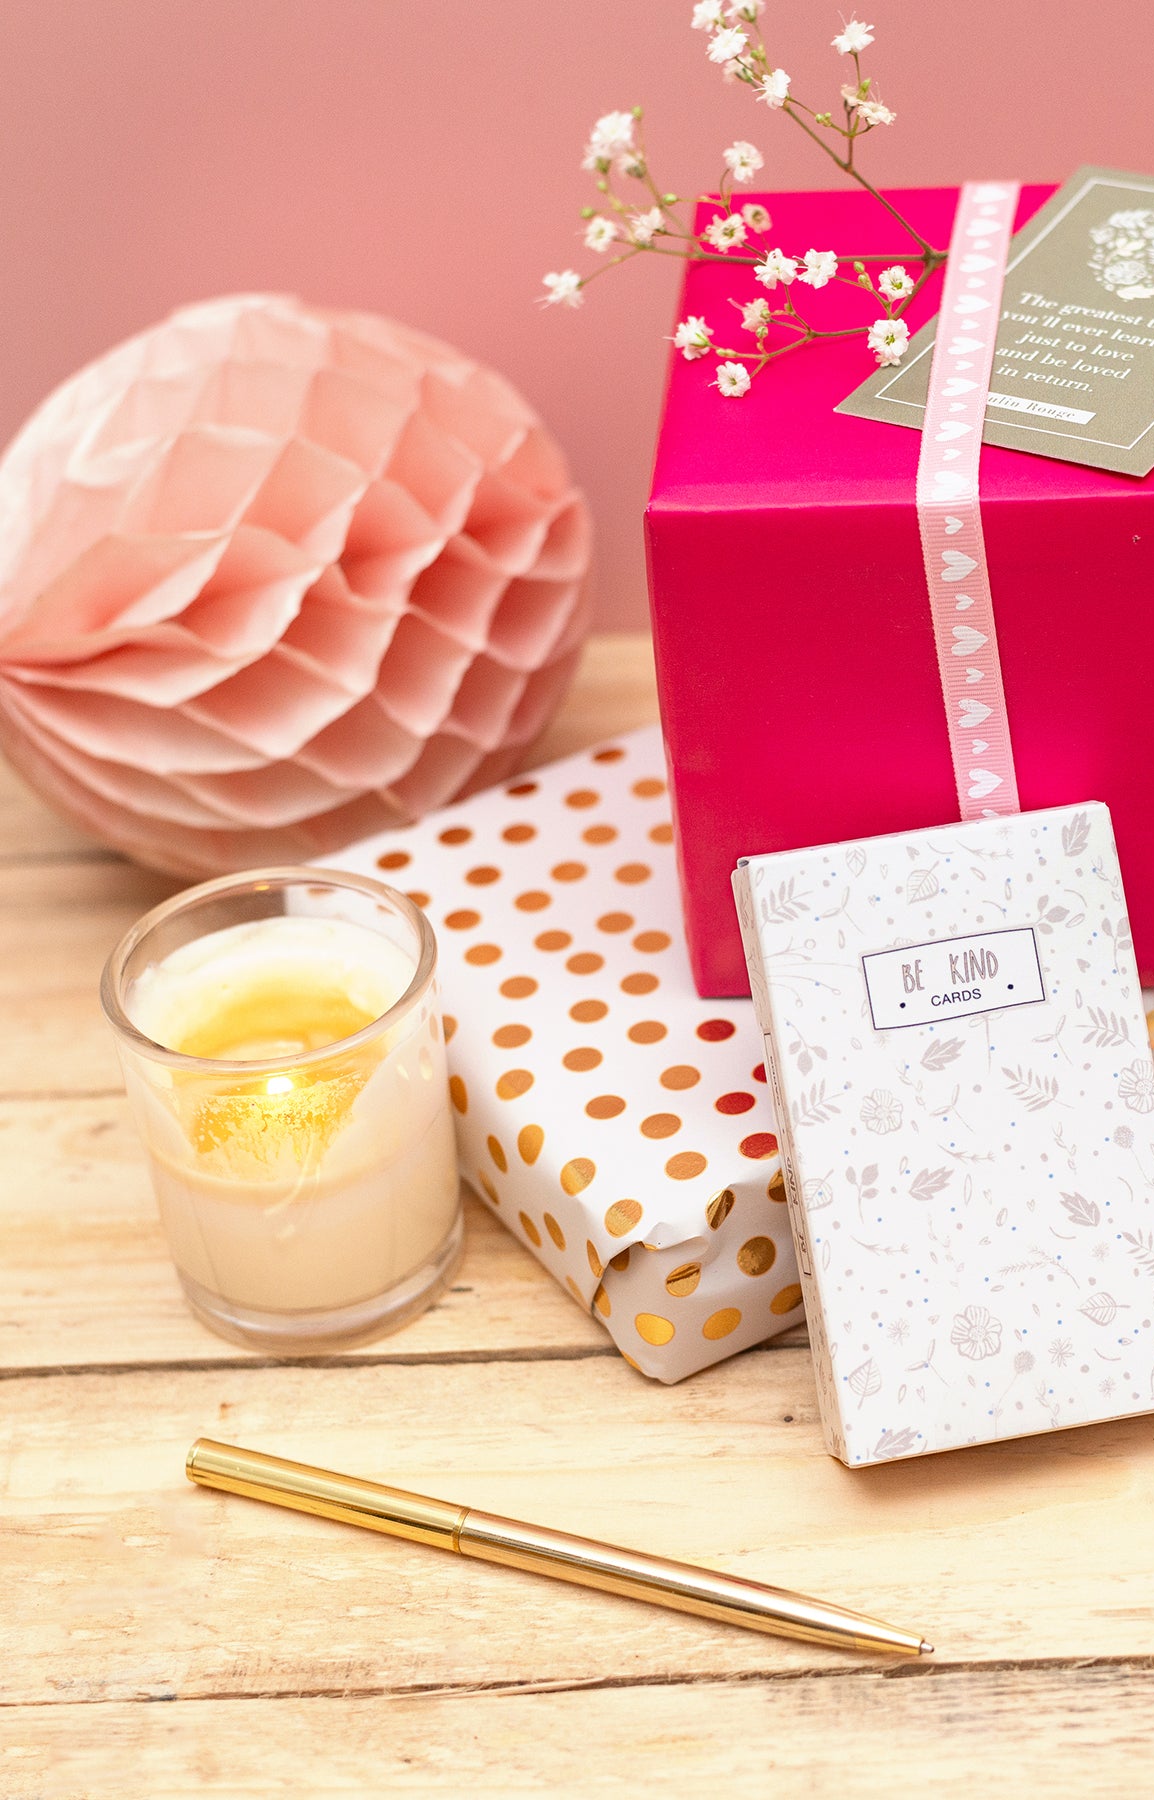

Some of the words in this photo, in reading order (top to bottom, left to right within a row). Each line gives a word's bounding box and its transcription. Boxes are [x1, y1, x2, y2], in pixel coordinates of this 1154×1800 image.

[1020, 292, 1058, 309] The
[1061, 303, 1143, 325] greatest
[1001, 310, 1059, 329] you'll
[1061, 322, 1109, 338] ever
[1015, 331, 1062, 348] just
[1065, 339, 1087, 353] to
[1092, 343, 1134, 362] love
[995, 347, 1036, 363] and
[1040, 350, 1067, 368] be
[1071, 357, 1132, 381] loved
[995, 363, 1019, 377] in
[1022, 372, 1094, 393] return.
[986, 396, 1021, 409] ulin
[1026, 402, 1076, 419] Rouge
[901, 959, 925, 994] BE
[949, 948, 999, 985] KIND
[930, 988, 982, 1008] CARDS
